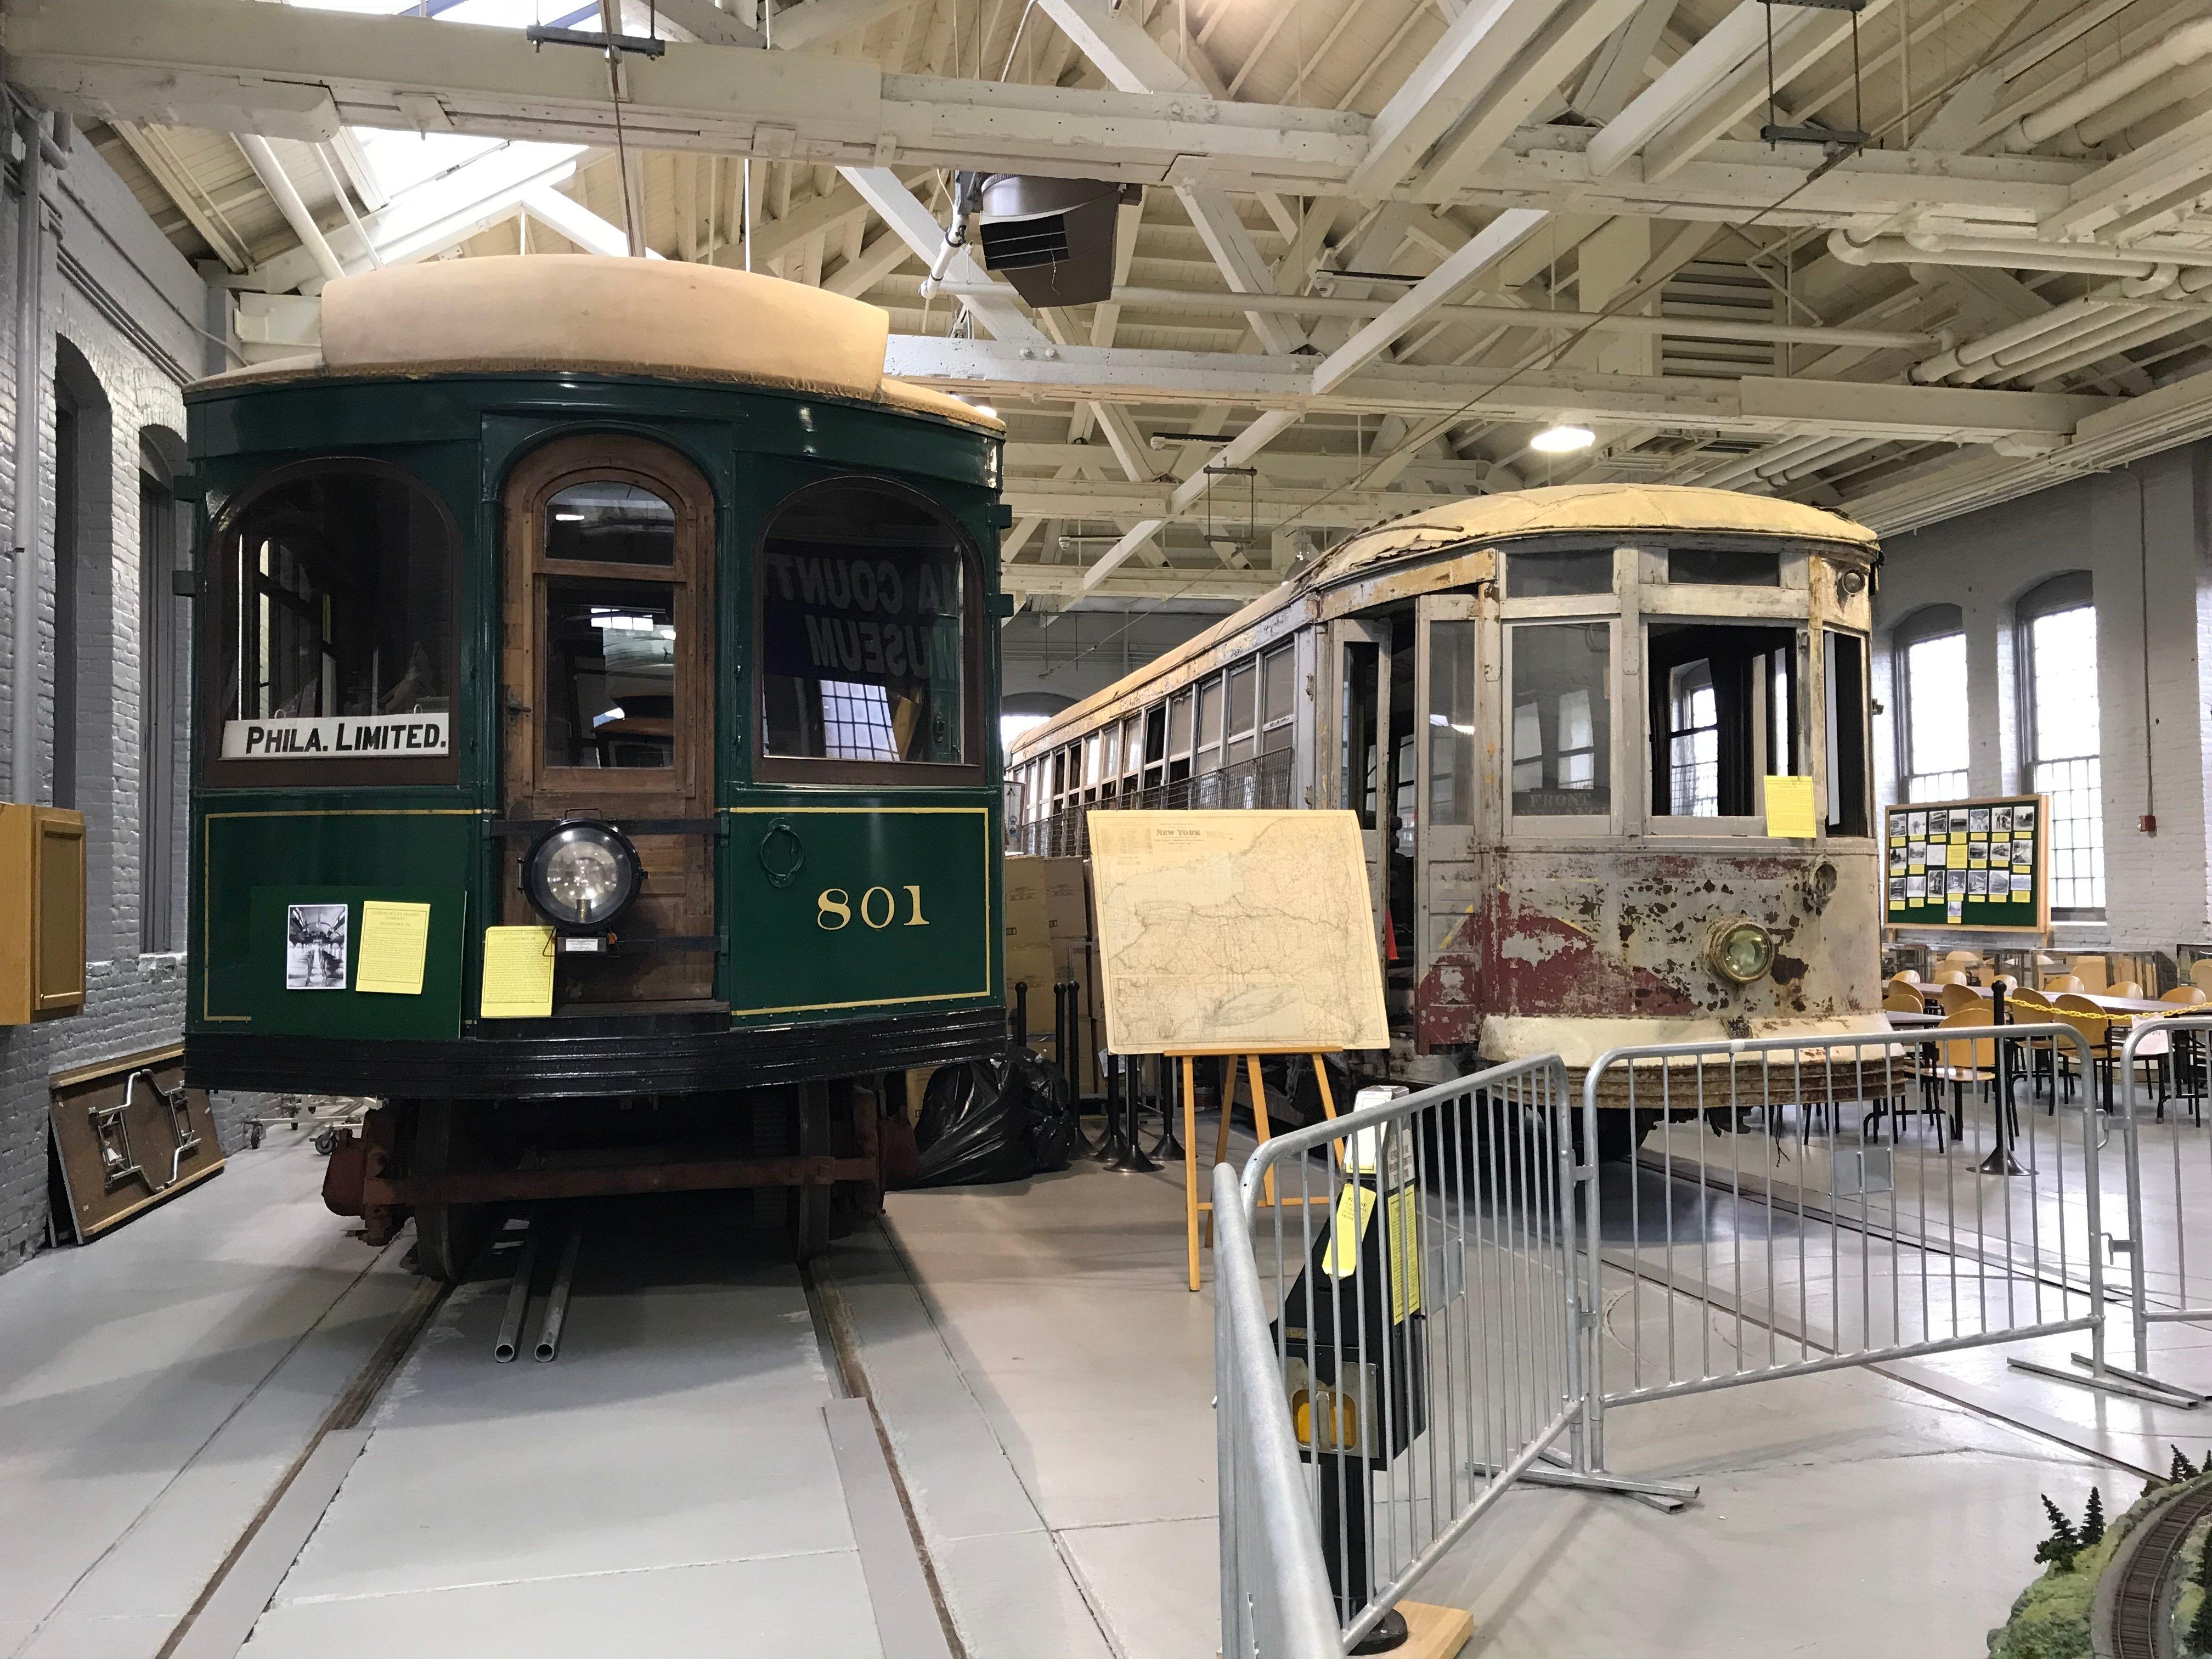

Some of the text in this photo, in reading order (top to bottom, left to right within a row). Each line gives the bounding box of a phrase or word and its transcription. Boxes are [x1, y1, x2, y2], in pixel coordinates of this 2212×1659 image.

[245, 723, 447, 754] PHILA. LIMITED.
[1530, 793, 1591, 808] FRONT
[817, 884, 930, 930] 801
